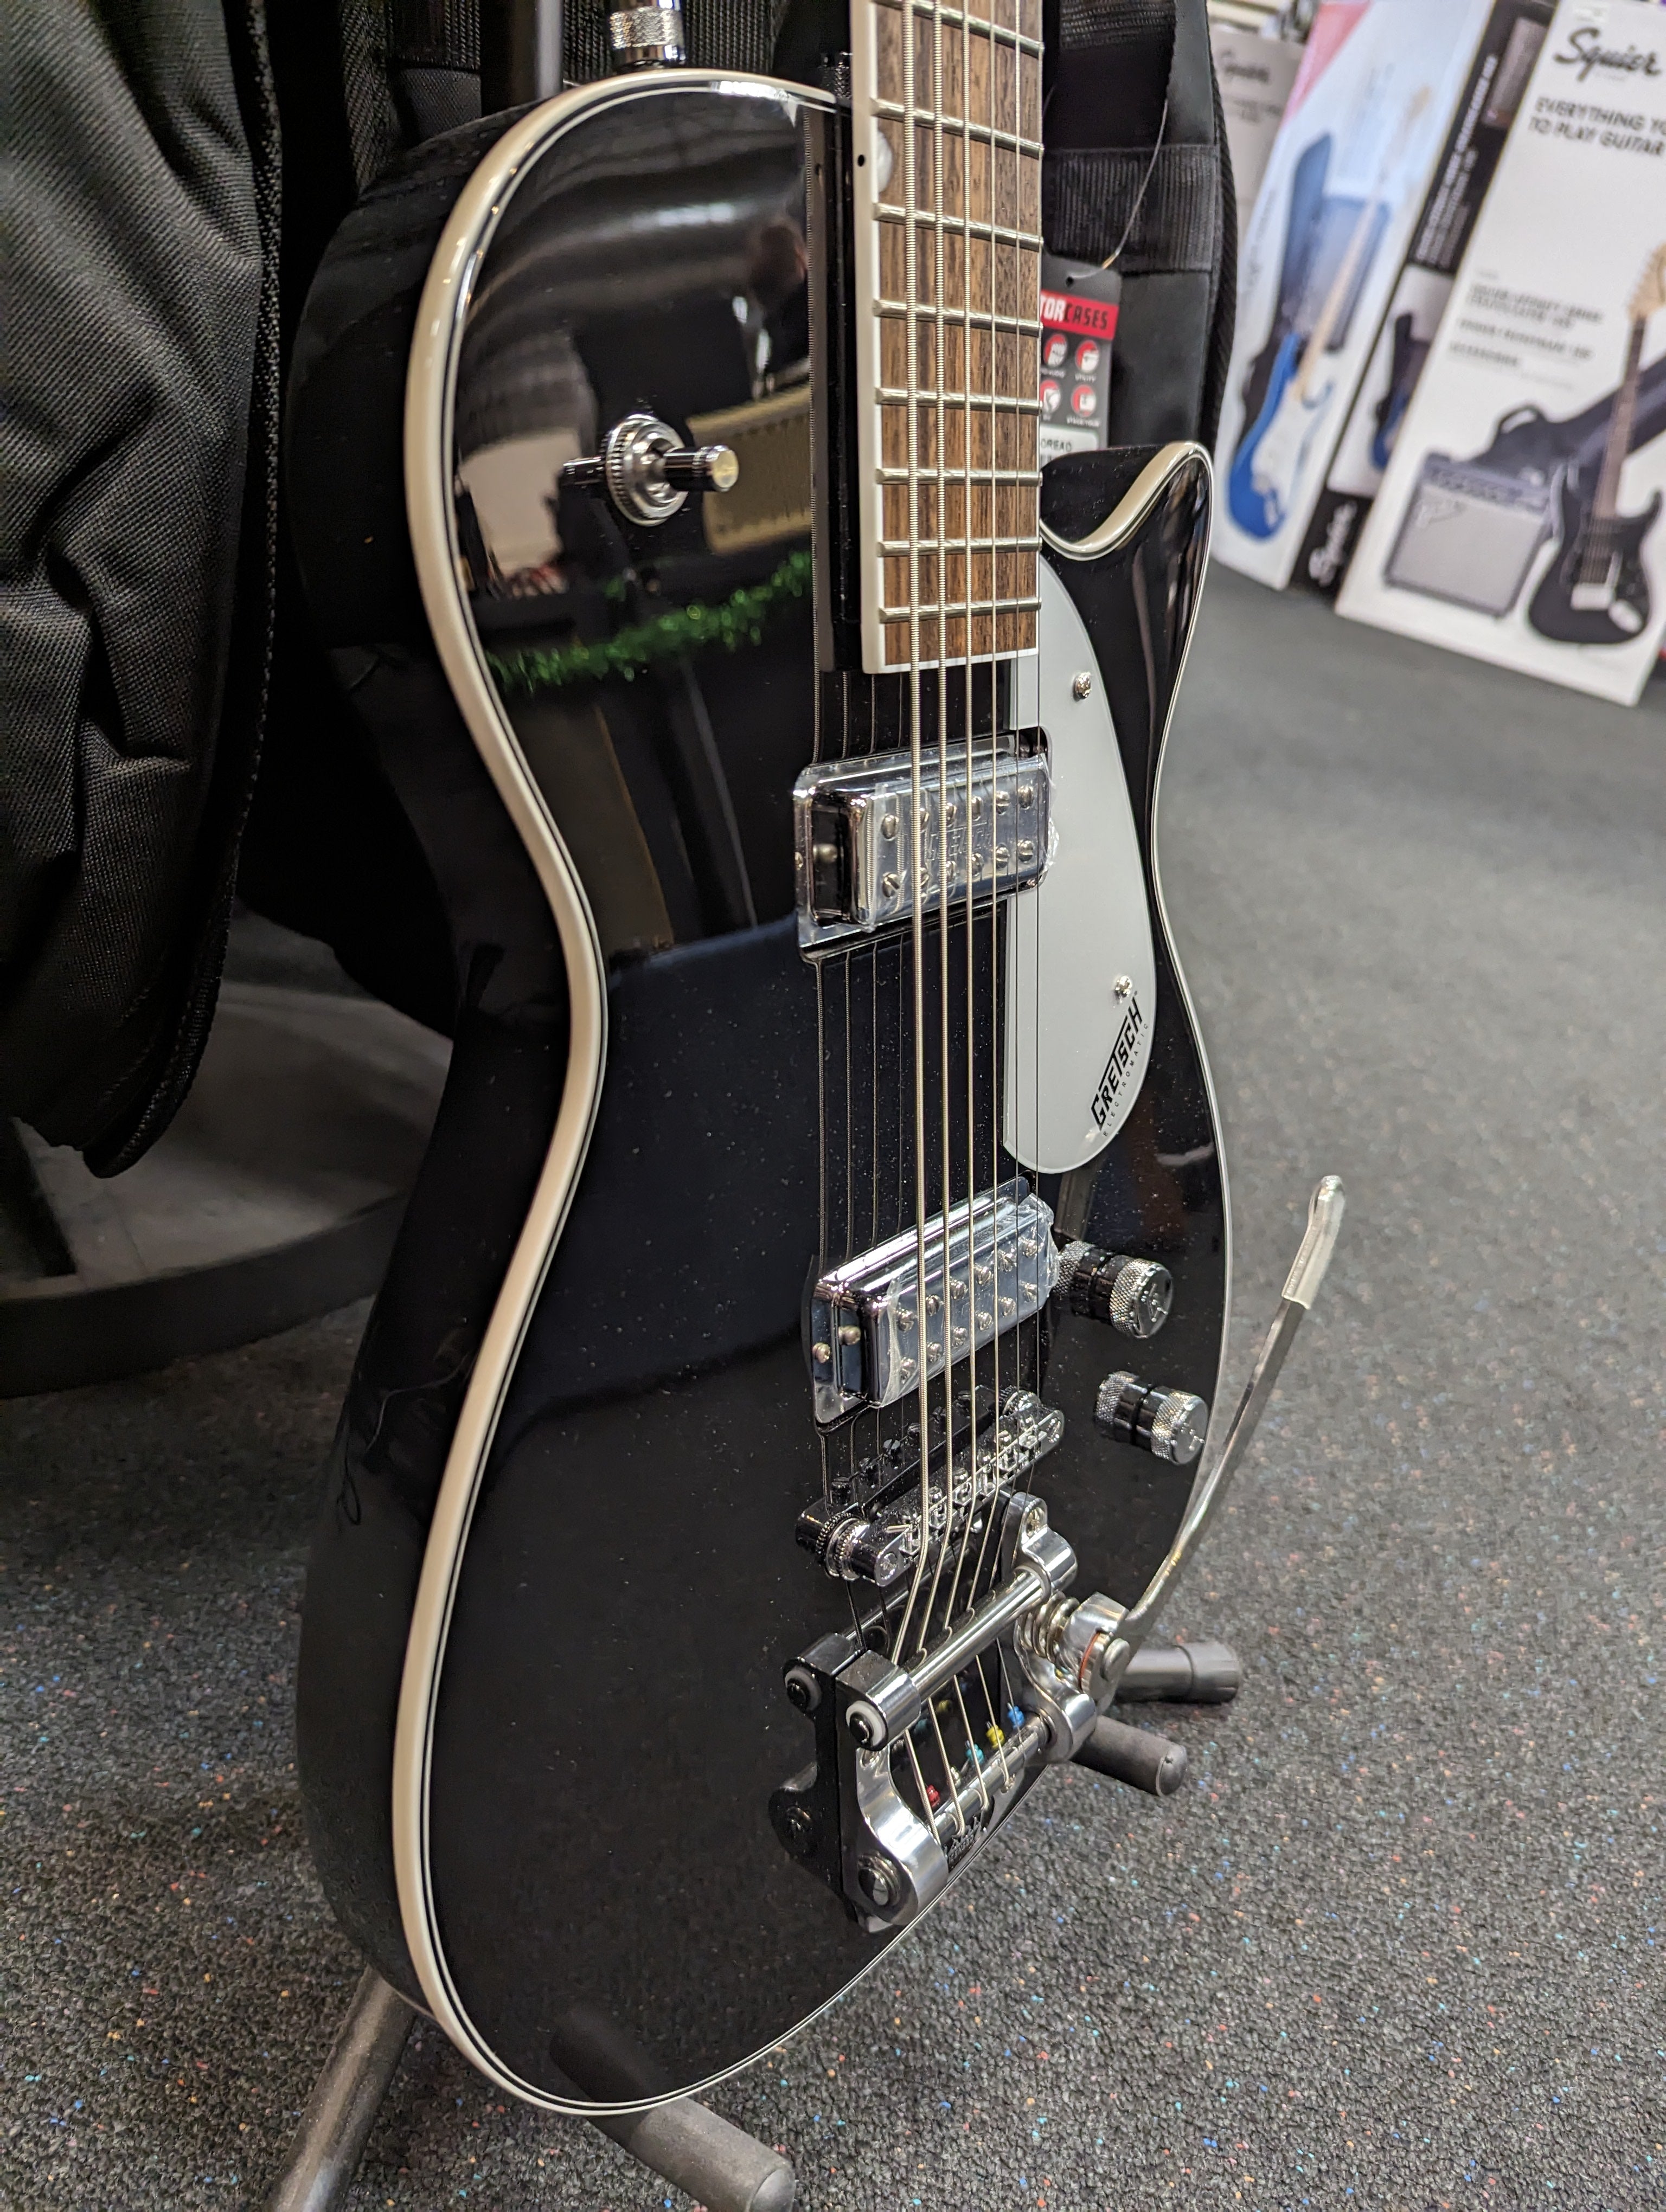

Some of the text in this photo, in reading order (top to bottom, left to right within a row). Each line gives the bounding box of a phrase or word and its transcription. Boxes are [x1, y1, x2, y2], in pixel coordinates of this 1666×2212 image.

[1553, 27, 1663, 82] Squier
[1528, 116, 1664, 155] TO PLAY GUITAR
[1534, 97, 1645, 131] EVERYTHING
[1091, 996, 1142, 1131] GRETSCH
[1103, 1023, 1148, 1137] ELECTROMATIC
